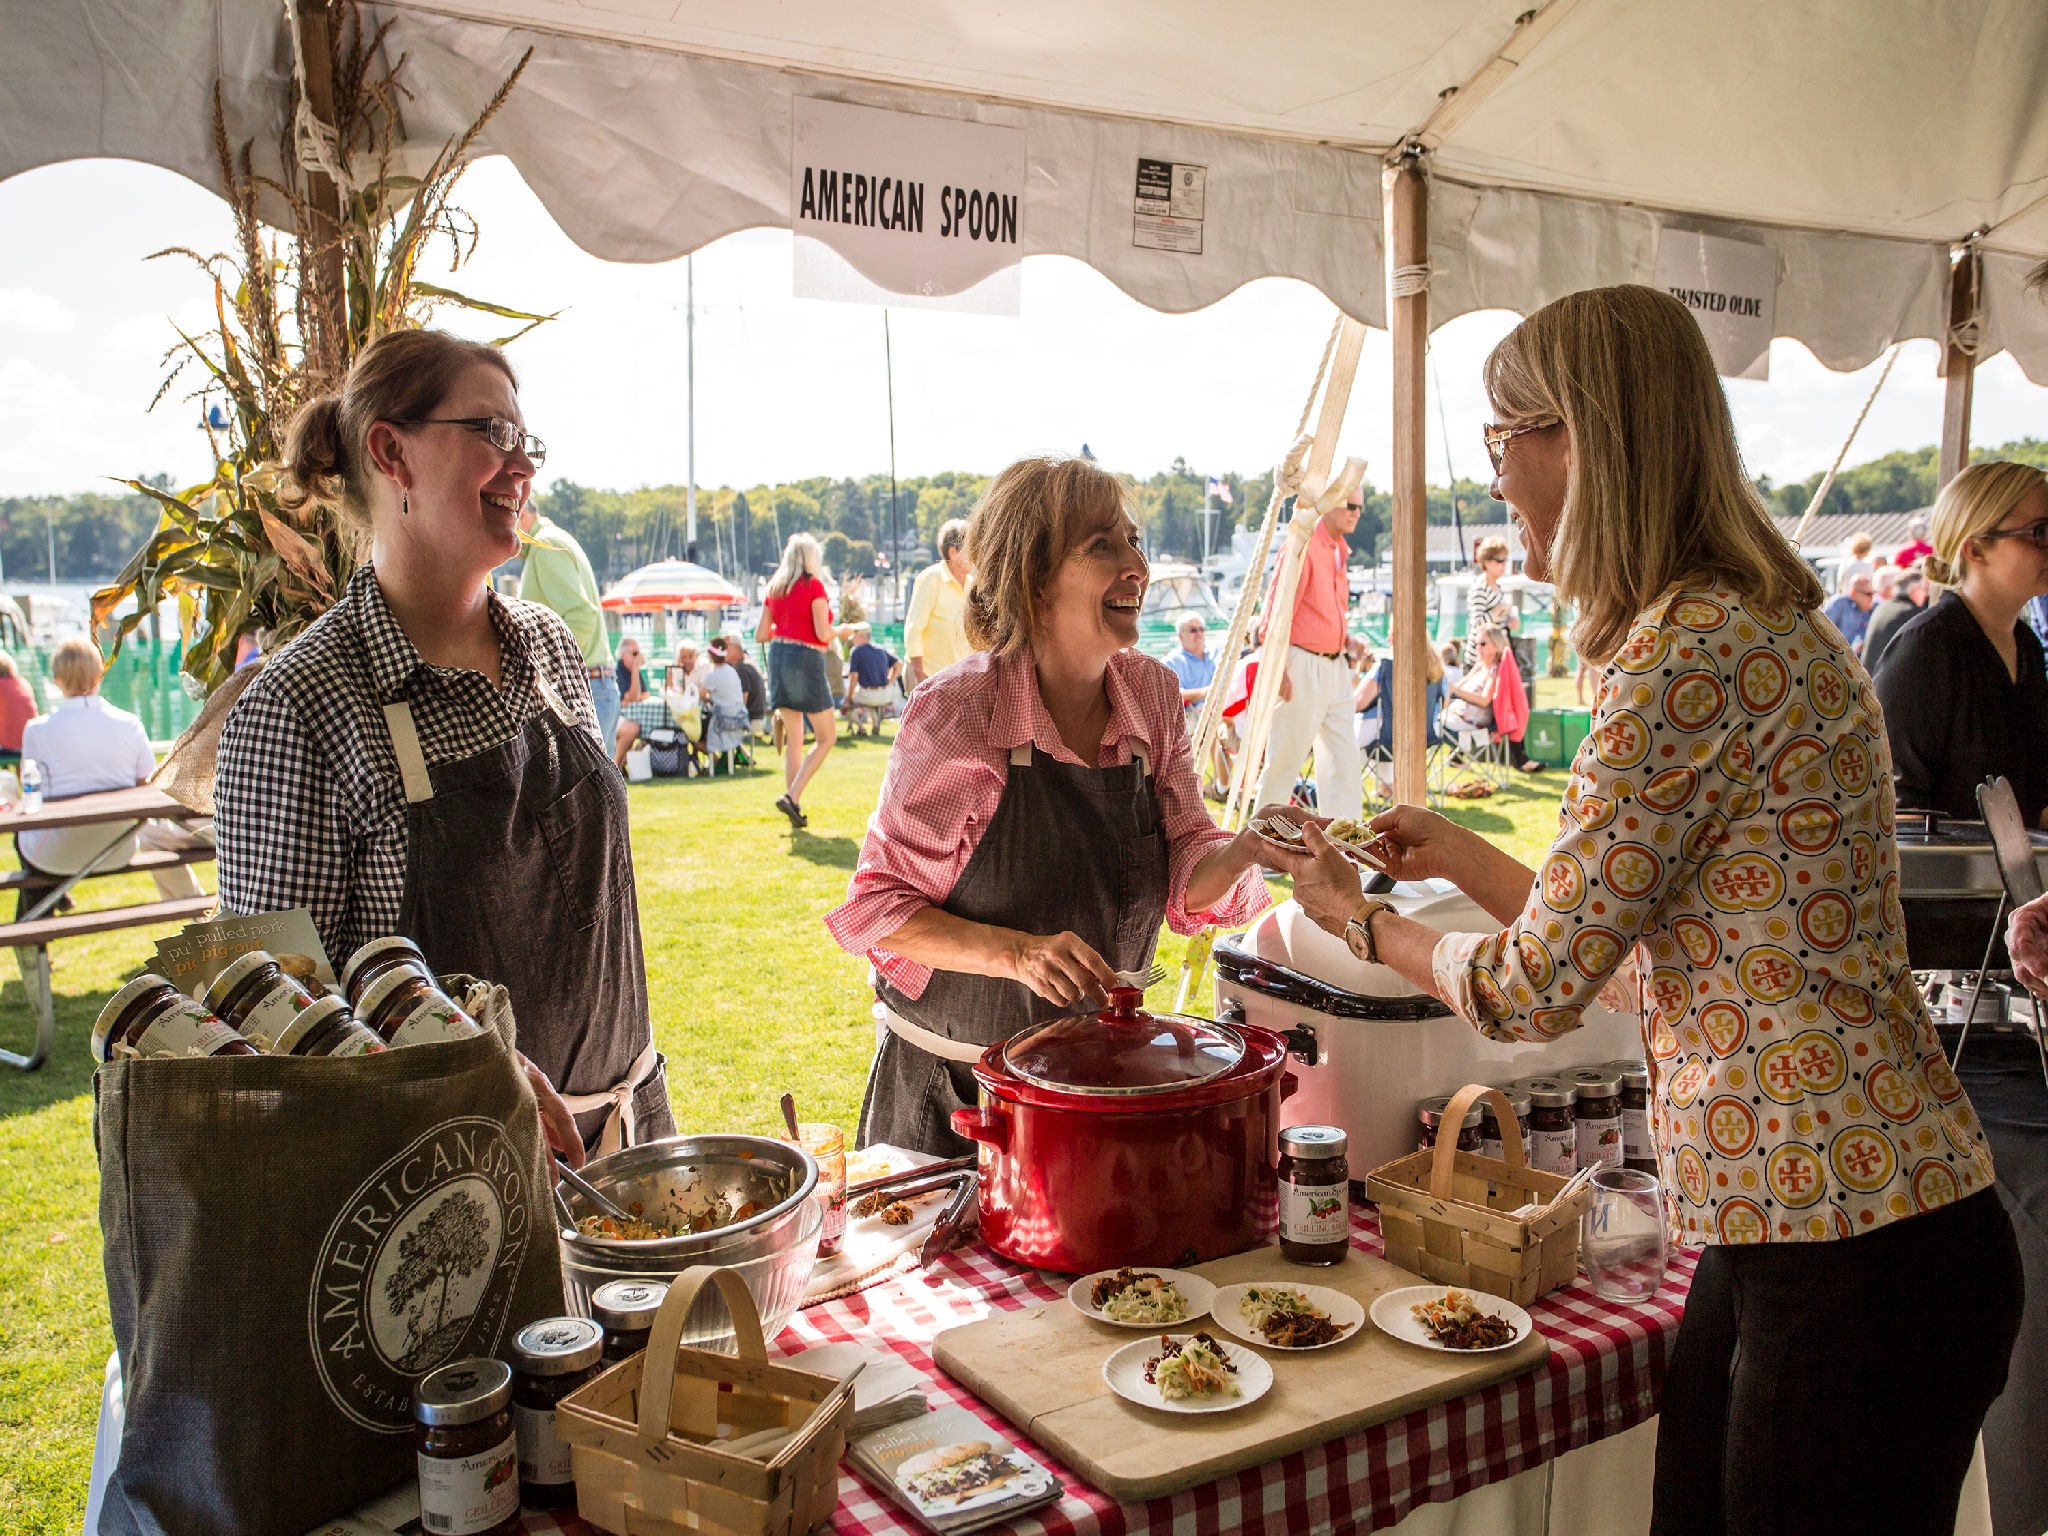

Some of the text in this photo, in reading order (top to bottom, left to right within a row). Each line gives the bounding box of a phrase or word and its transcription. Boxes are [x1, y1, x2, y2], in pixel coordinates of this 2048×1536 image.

[800, 166, 1018, 245] AMERICAN SPOON
[1730, 294, 1763, 318] OLIVE
[196, 918, 289, 947] pulled pork
[201, 940, 263, 962] pig-out
[323, 1129, 528, 1361] AMERICAN SPOON
[352, 1371, 409, 1412] ESTAB
[871, 1430, 920, 1455] pulled
